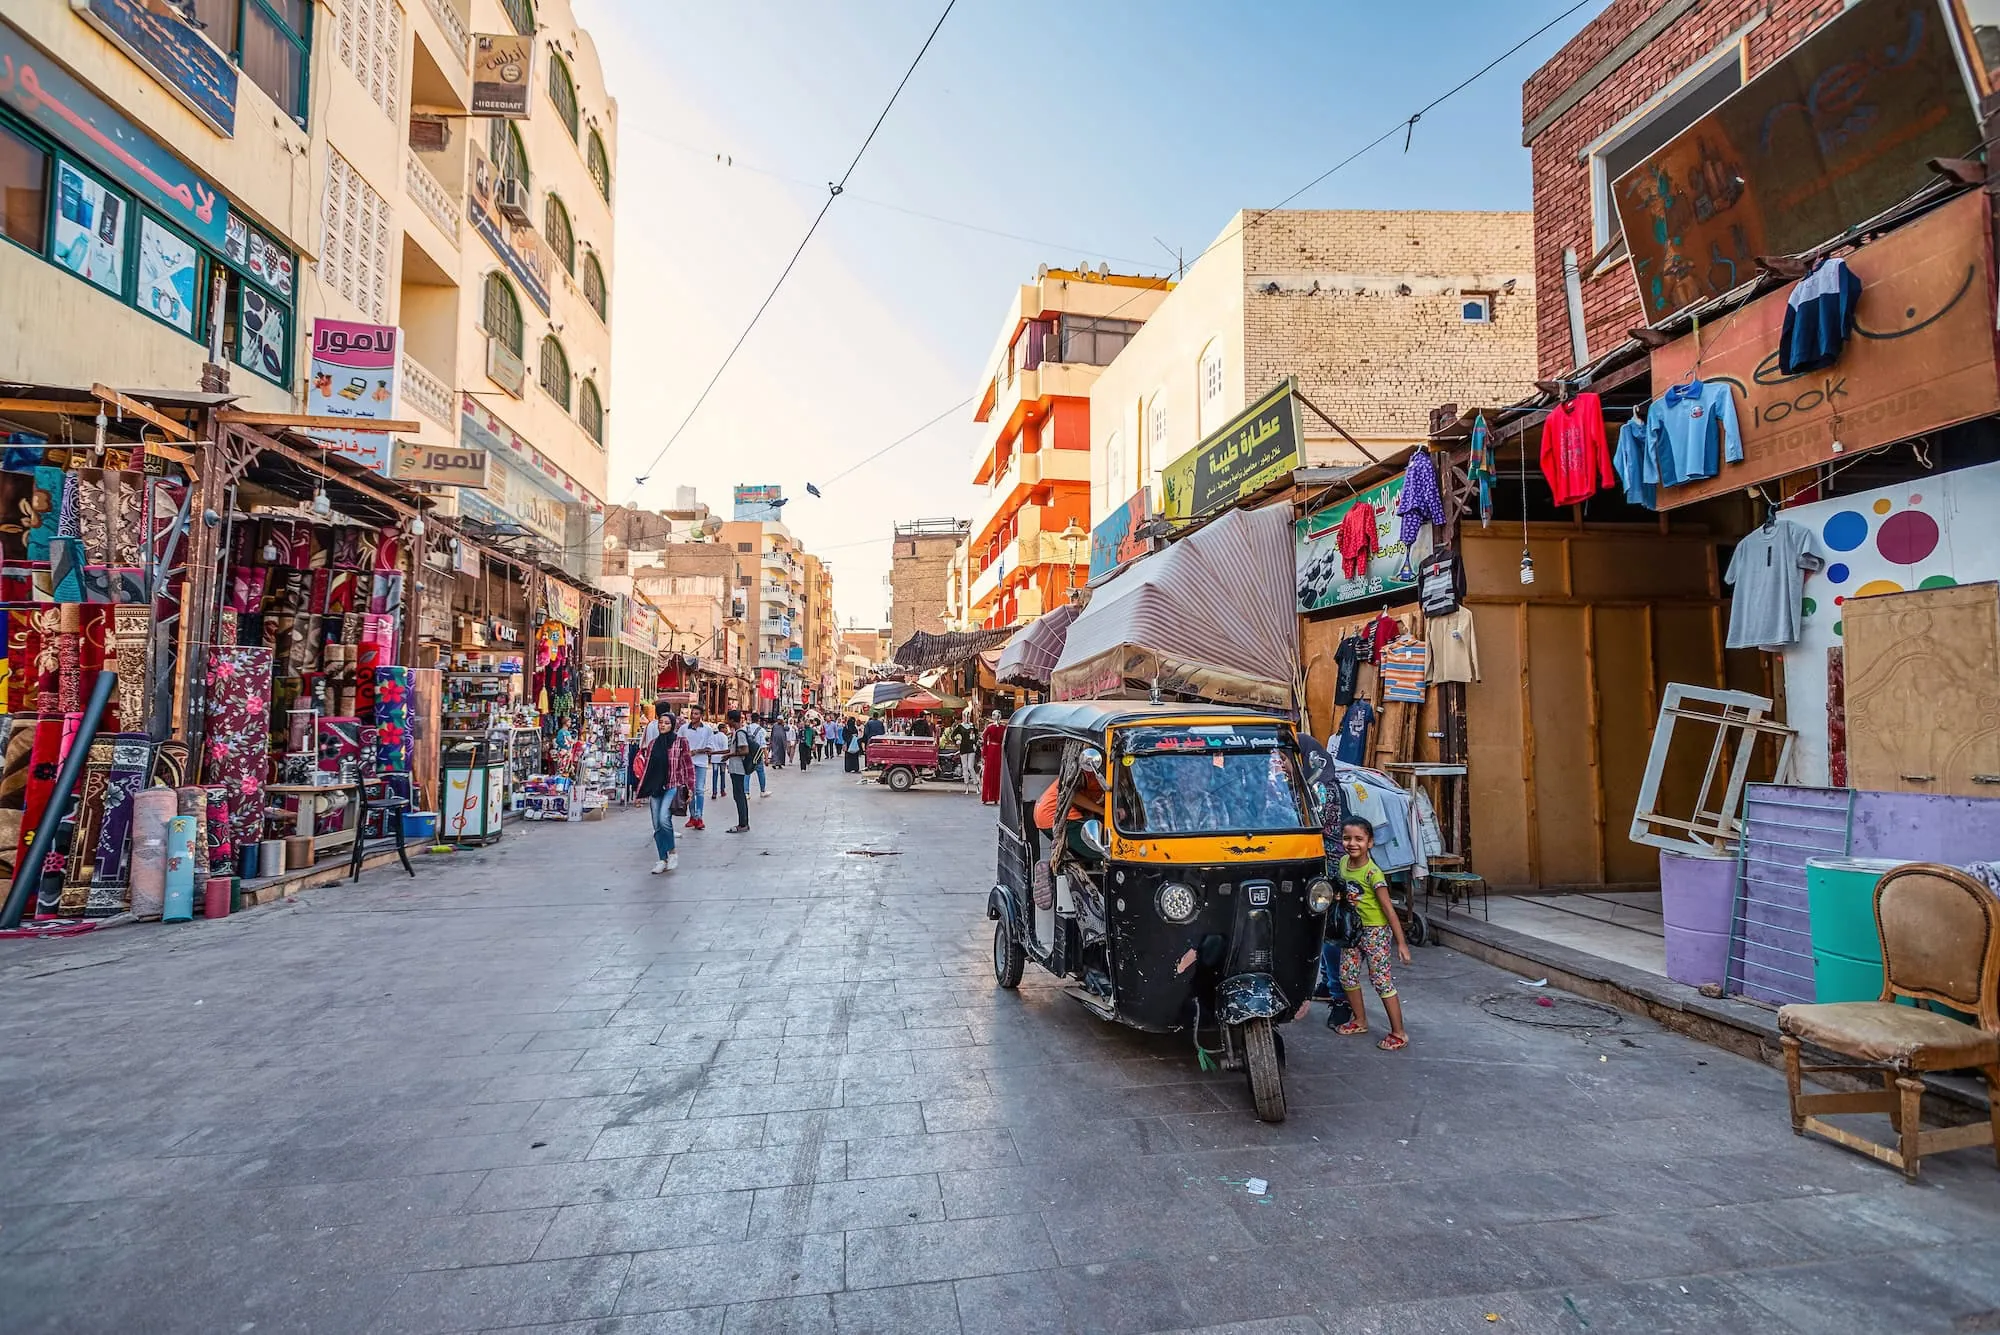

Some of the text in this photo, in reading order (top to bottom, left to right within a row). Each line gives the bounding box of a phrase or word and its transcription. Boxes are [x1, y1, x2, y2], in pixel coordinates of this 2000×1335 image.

[316, 328, 395, 353] لامور
[1239, 415, 1280, 457] عطارة
[422, 452, 485, 470] لامور
[1208, 440, 1239, 475] طيبة
[495, 621, 518, 643] CRAZY
[1206, 735, 1222, 747] ما
[1224, 734, 1247, 747] الله
[1249, 736, 1279, 749] بسم
[1253, 891, 1267, 902] RE
